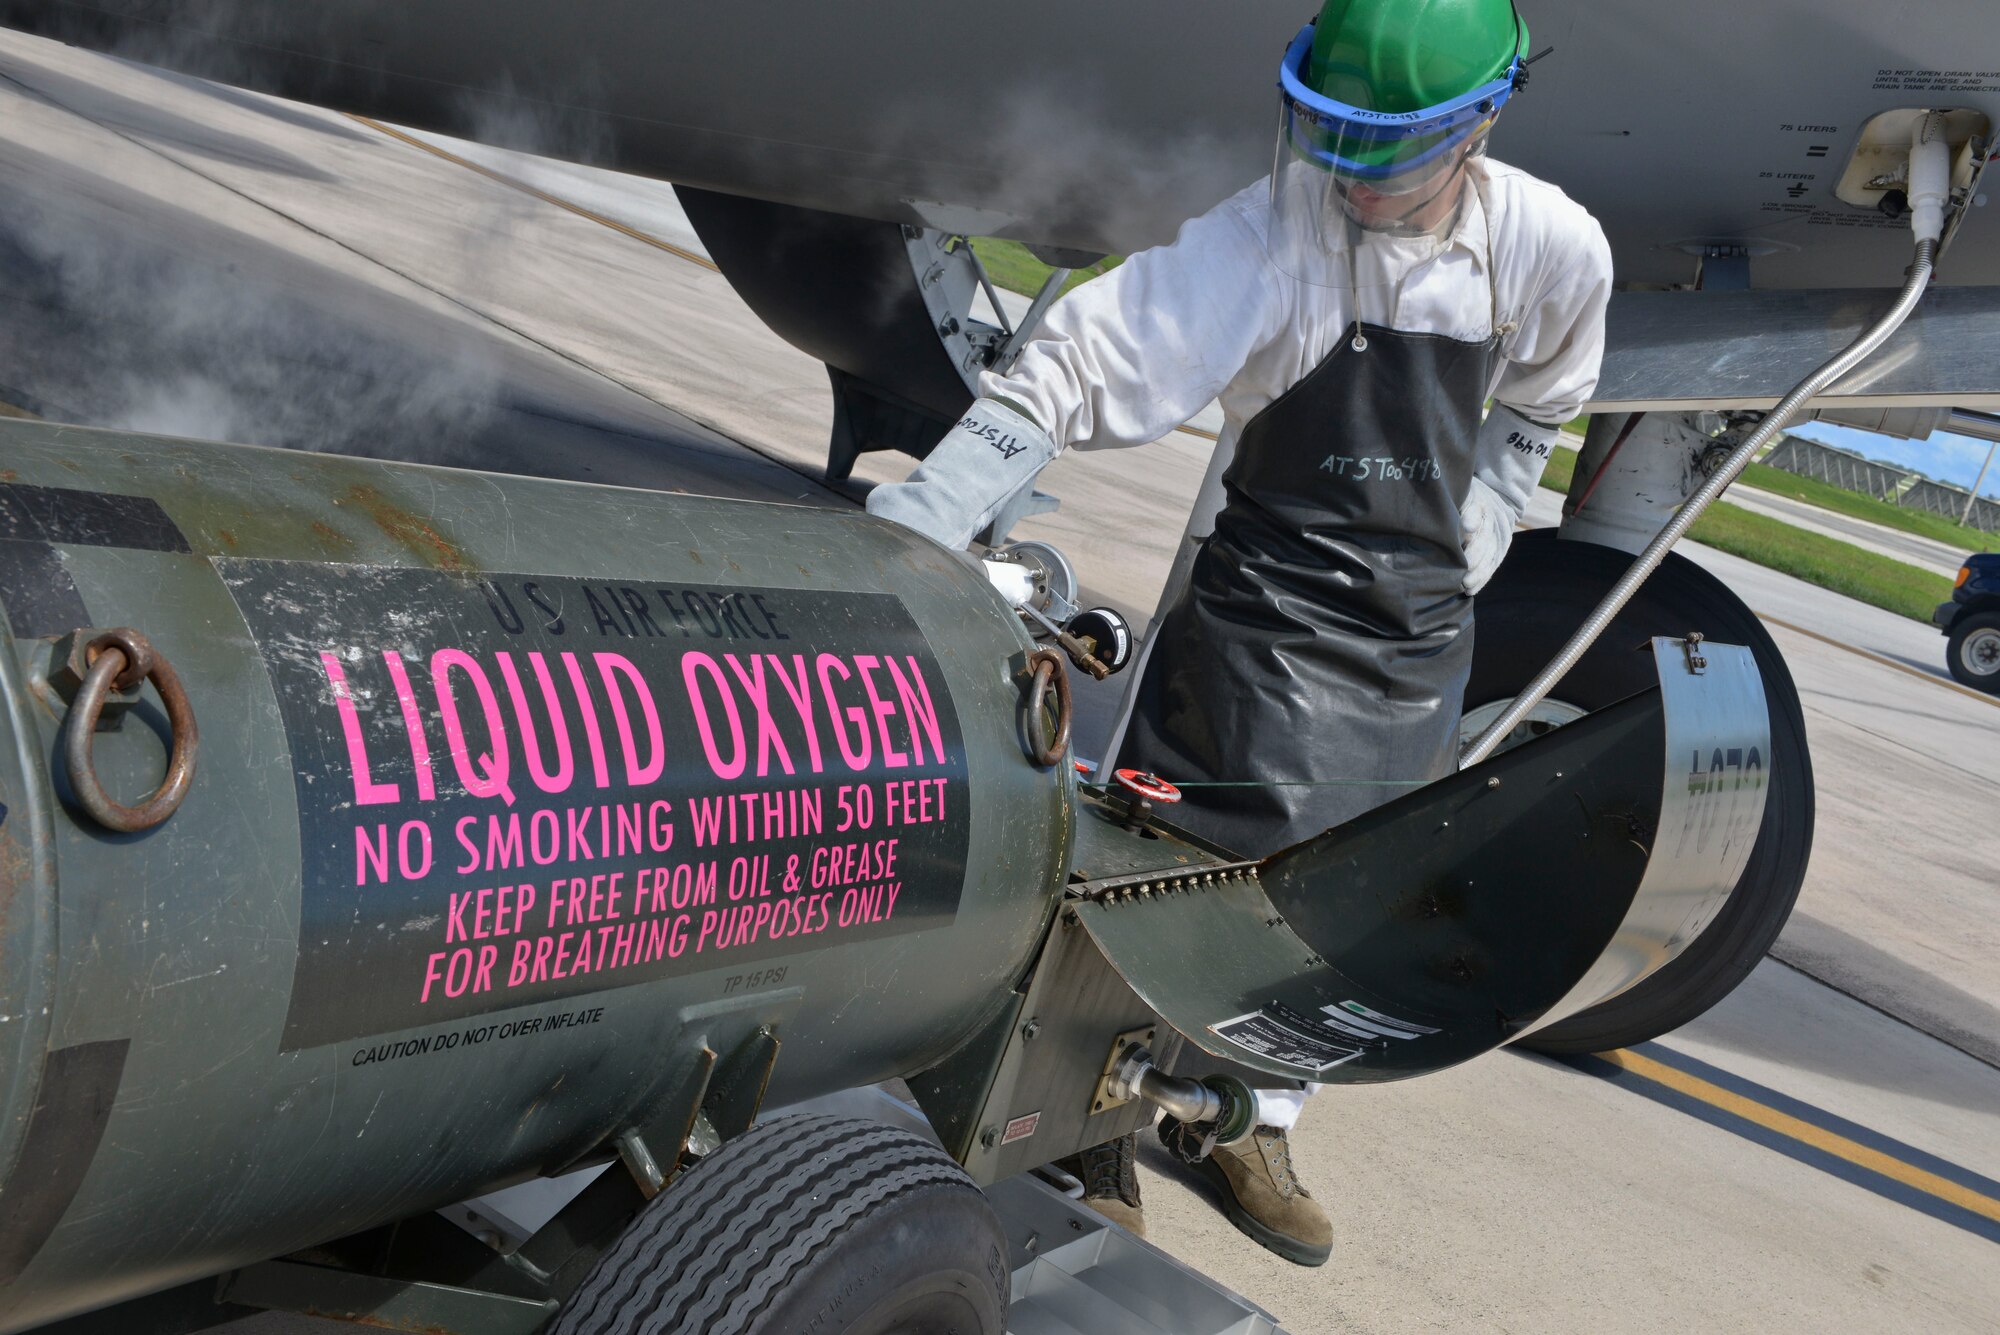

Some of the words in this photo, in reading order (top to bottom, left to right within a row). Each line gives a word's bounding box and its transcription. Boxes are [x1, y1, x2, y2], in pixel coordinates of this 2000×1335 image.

[1779, 123, 1794, 131] 75
[1797, 124, 1839, 133] LITERS
[1758, 171, 1773, 179] 25
[1775, 173, 1816, 181] LITERS
[958, 417, 1028, 461] ATST00
[480, 581, 525, 636] U
[524, 581, 566, 636] S
[581, 586, 668, 638] AIR
[656, 589, 790, 641] FORCE
[318, 649, 667, 807] LIQUID
[681, 650, 947, 780] OXYGEN
[354, 819, 434, 886] NO
[454, 799, 675, 875] SMOKING
[687, 786, 823, 848] WITHIN
[835, 784, 875, 832] 50
[885, 778, 949, 826] FEET
[444, 882, 537, 944] KEEP
[546, 871, 625, 929] FREE
[632, 860, 718, 917] FROM
[727, 854, 773, 902] OIL
[781, 854, 802, 894] &
[810, 838, 900, 890] GREASE
[420, 943, 495, 1004] FOR
[507, 914, 692, 989] BREATHING
[694, 884, 835, 954] PURPOSES
[837, 881, 902, 929] ONLY
[724, 975, 743, 993] TP
[746, 971, 761, 990] 15
[762, 966, 788, 986] PSI
[352, 1036, 431, 1067] CAUTION
[432, 1031, 460, 1052] DO
[461, 1025, 498, 1047] NOT
[499, 1017, 543, 1040] OVER
[543, 1007, 605, 1032] INFLATE
